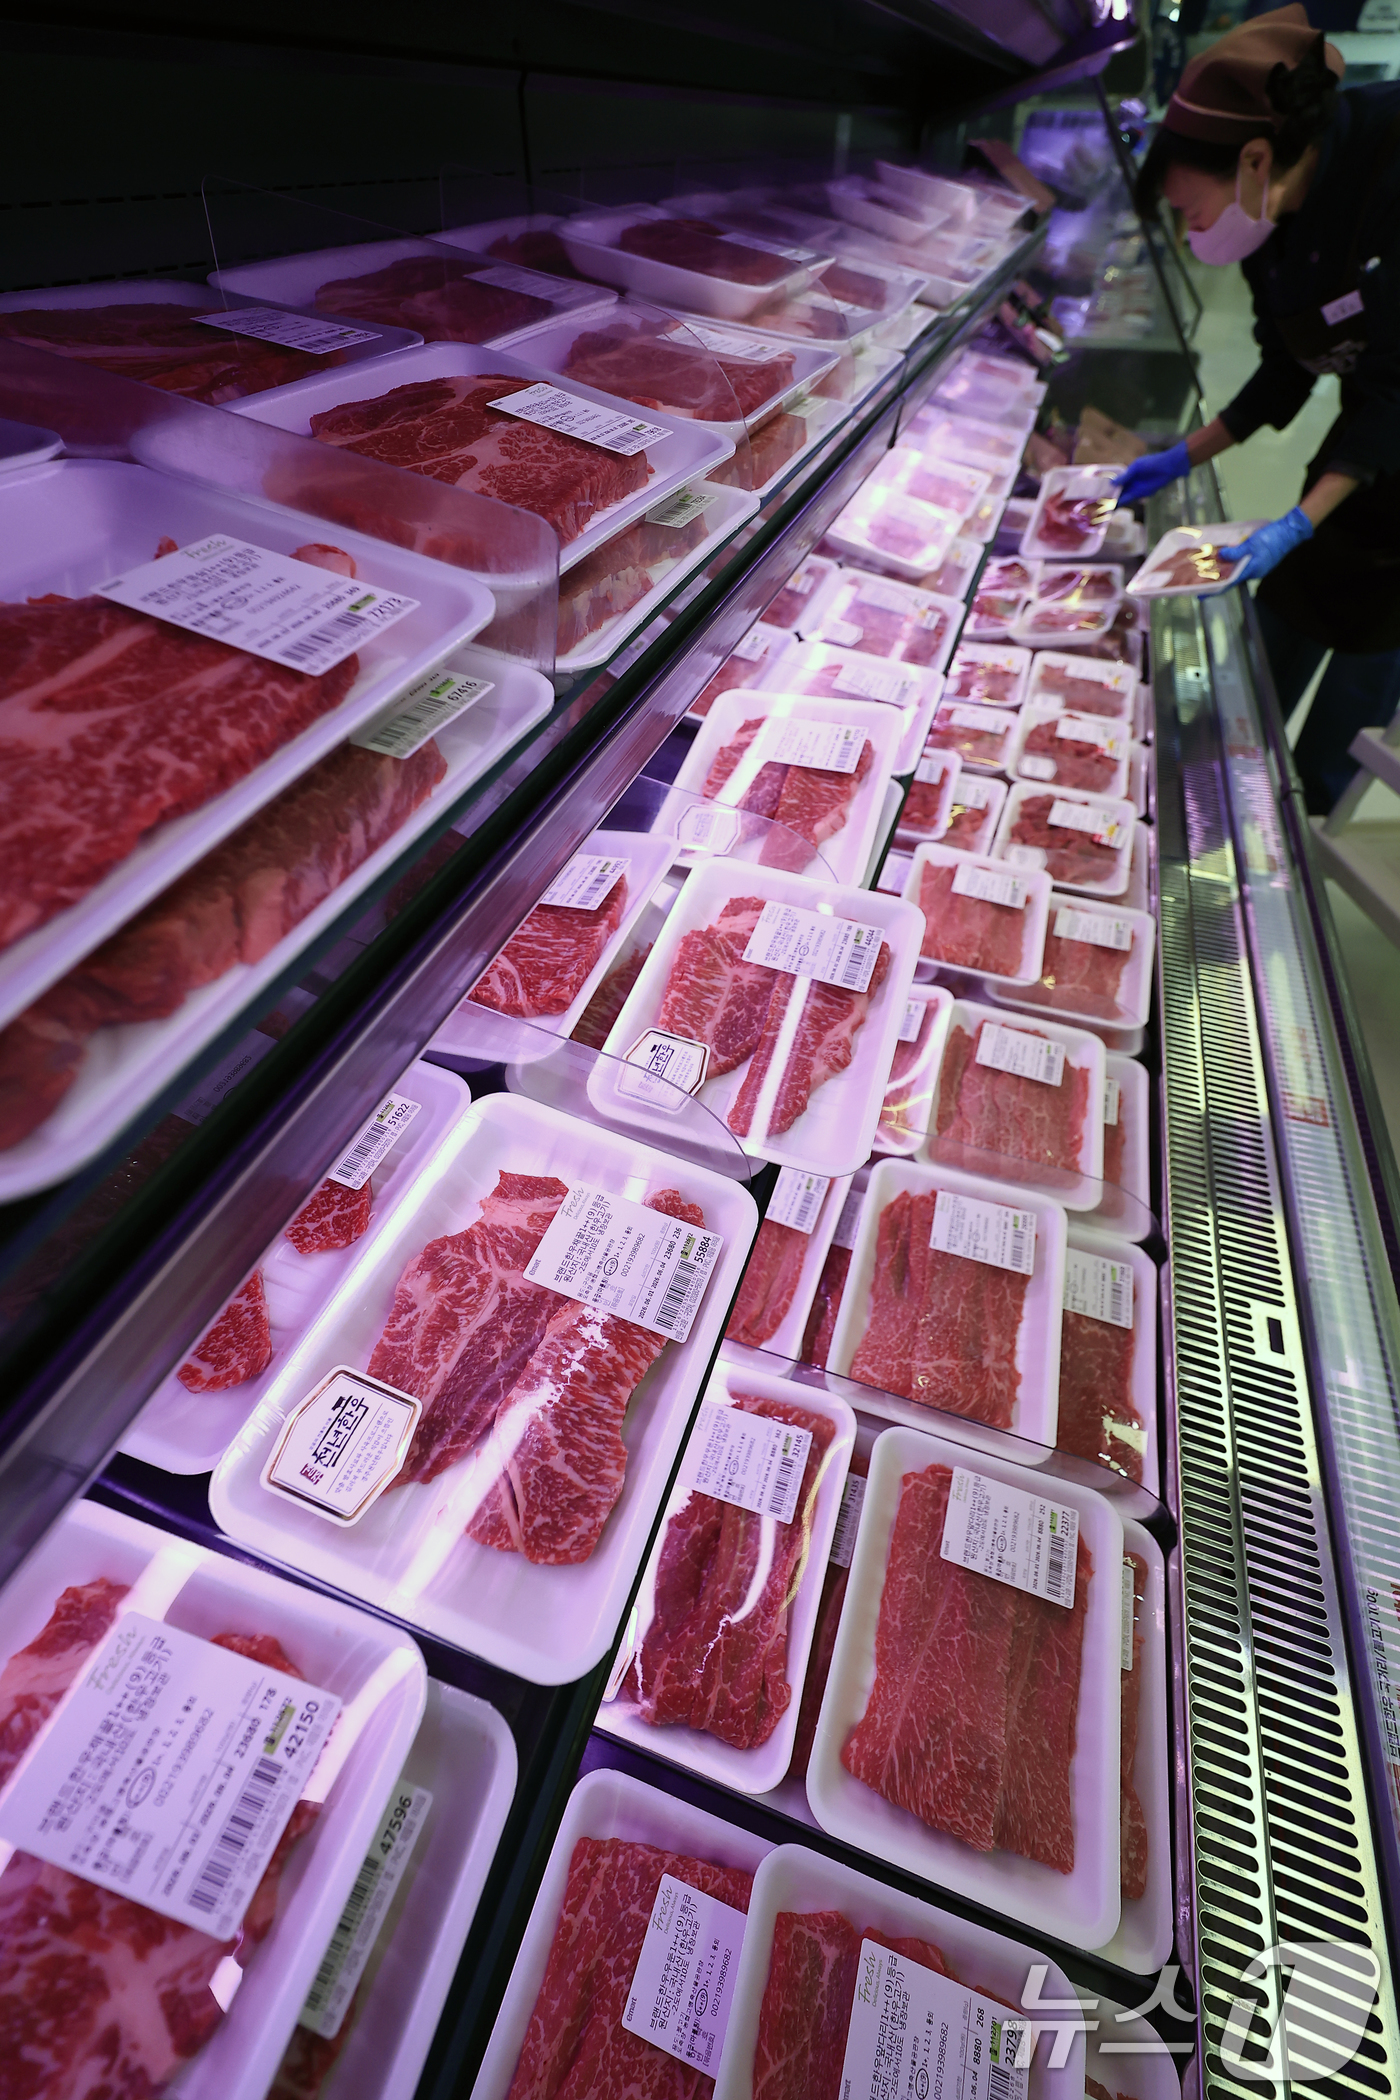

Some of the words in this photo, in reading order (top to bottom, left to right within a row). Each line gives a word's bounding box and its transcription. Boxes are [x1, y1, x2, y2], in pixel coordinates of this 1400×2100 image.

[179, 536, 230, 558] Fresh
[365, 596, 403, 618] 72173
[445, 680, 478, 701] 67416
[864, 929, 875, 945] 44044
[387, 1102, 410, 1125] 51622
[559, 1185, 586, 1218] Fresh
[596, 1212, 613, 1236] 냉장보관
[620, 1232, 645, 1277] 002193989682
[693, 1235, 711, 1263] 55884
[638, 1289, 654, 1319] 2026.06.01
[651, 1260, 666, 1288] 2026.06.04
[663, 1239, 676, 1259] 23680
[672, 1226, 682, 1238] 236
[310, 1393, 373, 1470] 천년한우
[792, 1434, 804, 1457] 32145
[1060, 1510, 1070, 1536] 22377
[1364, 1585, 1381, 1617] 100g
[84, 1623, 140, 1693] Fresh
[233, 1716, 262, 1759] 23680
[258, 1686, 278, 1711] 178
[281, 1699, 321, 1760] 42150
[377, 1795, 413, 1856] 47596
[651, 1882, 673, 1932] Fresh
[686, 1920, 700, 1956] 냉장보관
[710, 1946, 732, 2018] 002193989682
[857, 1948, 877, 2005] Fresh
[626, 1995, 637, 2022] emart
[898, 1990, 910, 2031] 냉장보관
[976, 2006, 984, 2028] 268
[973, 2036, 982, 2065] 8880
[1005, 2017, 1017, 2067] 23798
[934, 2021, 948, 2100] 002193989682
[842, 2078, 851, 2100] mart
